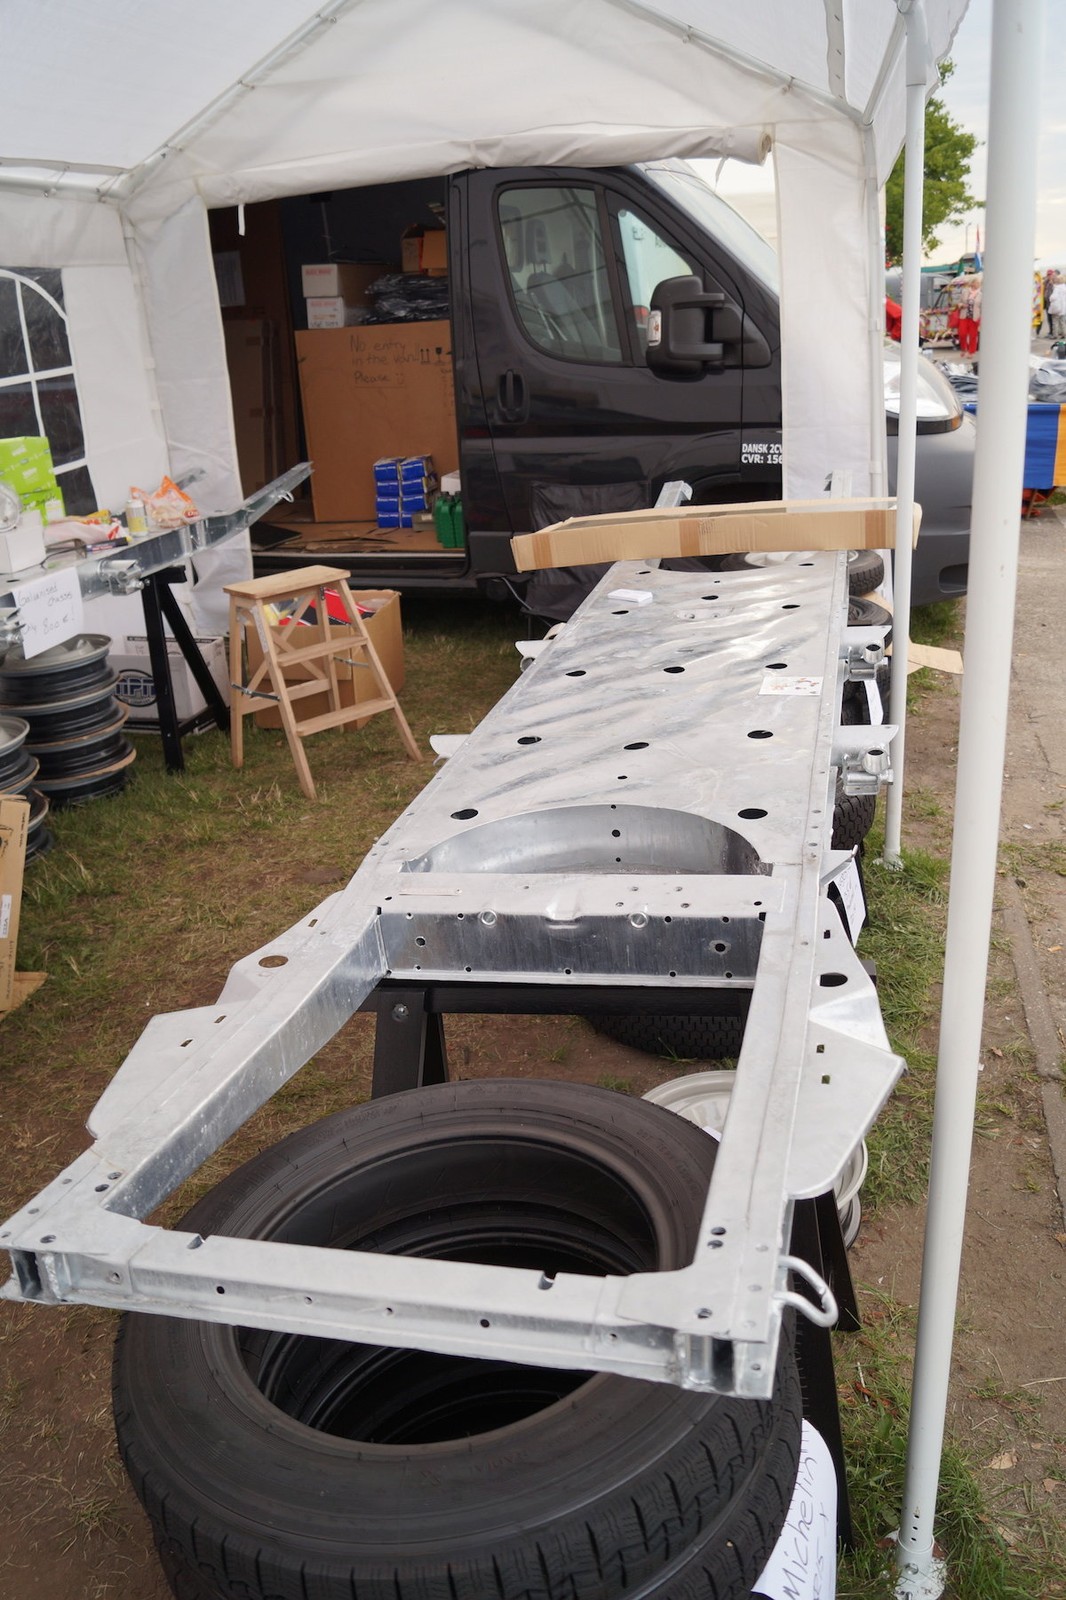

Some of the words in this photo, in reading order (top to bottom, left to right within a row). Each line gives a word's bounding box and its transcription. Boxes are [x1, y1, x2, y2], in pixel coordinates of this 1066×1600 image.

[350, 335, 366, 352] No
[374, 339, 406, 356] entry
[742, 443, 768, 453] DANSK
[741, 453, 764, 464] CVR:
[782, 1456, 818, 1600] Michelin
